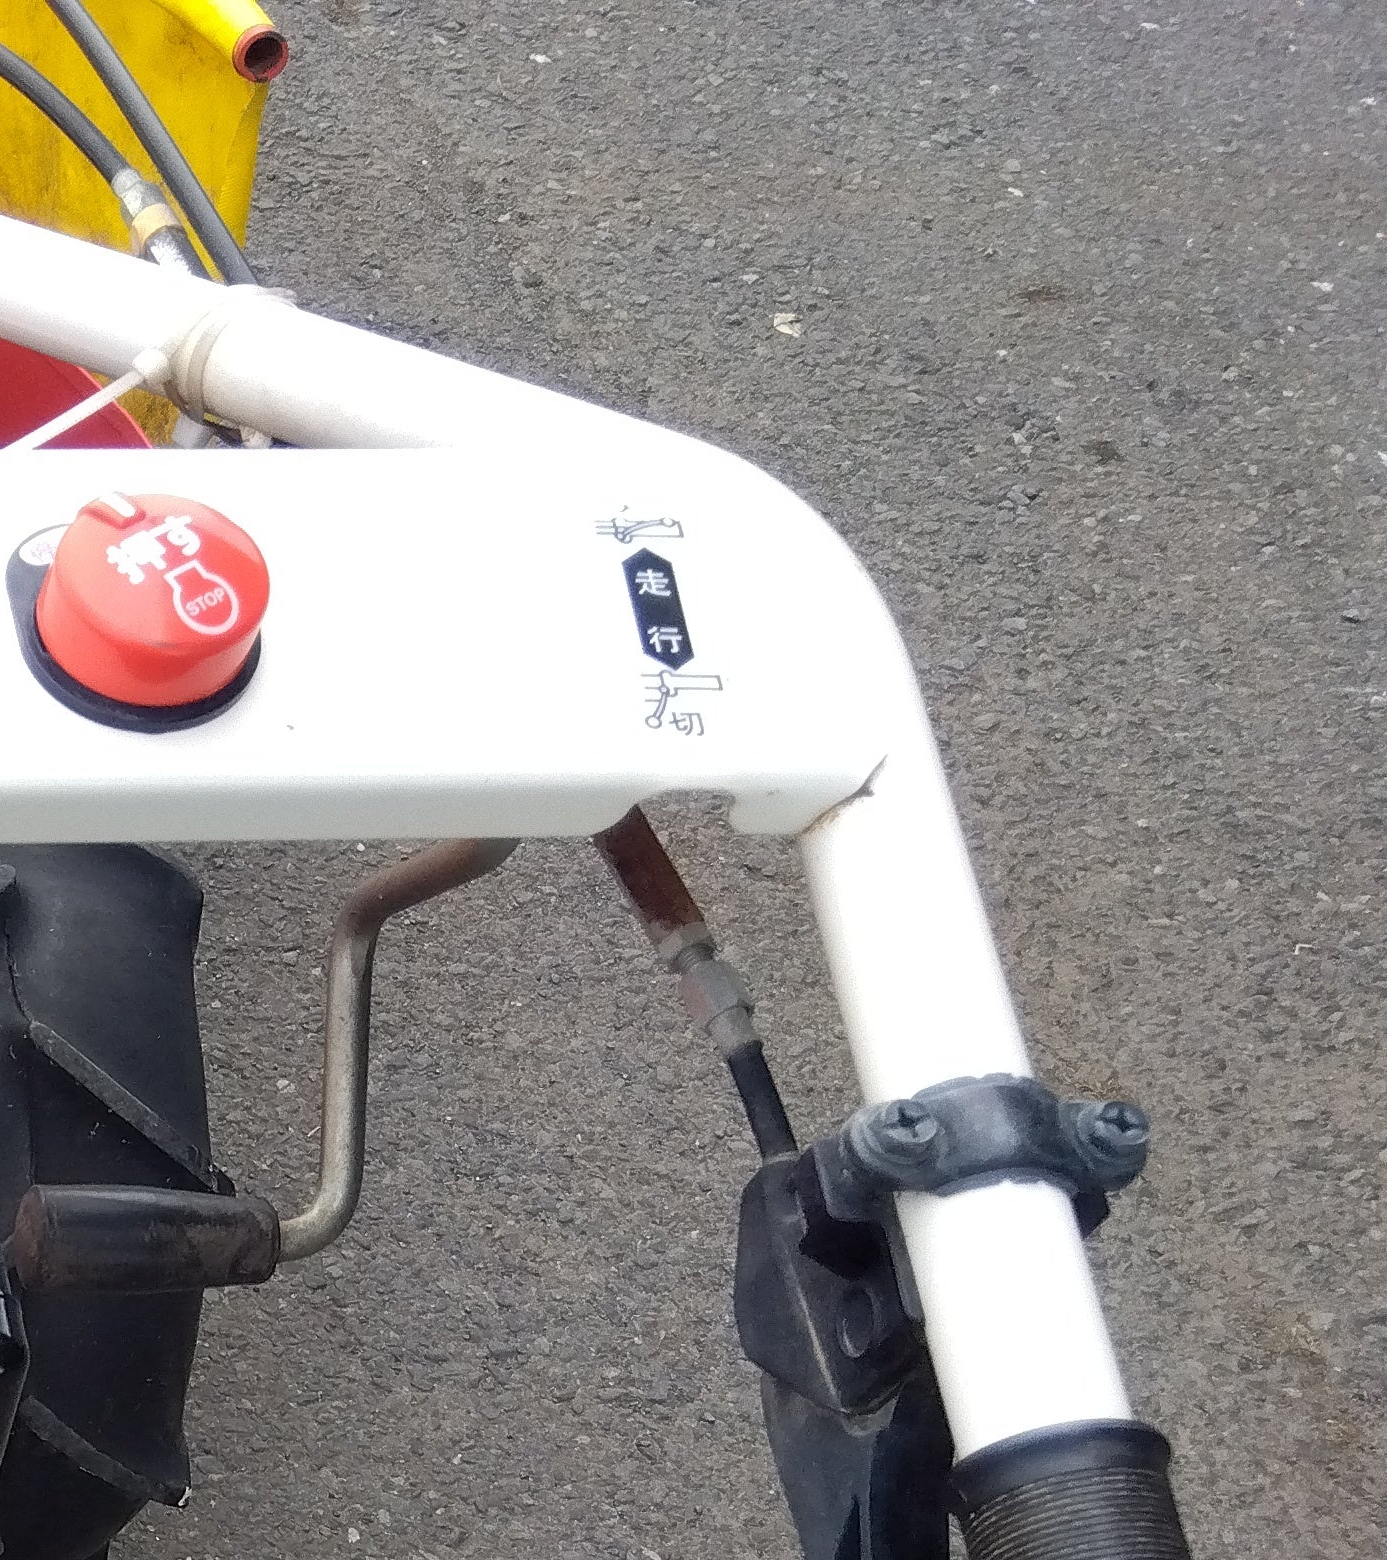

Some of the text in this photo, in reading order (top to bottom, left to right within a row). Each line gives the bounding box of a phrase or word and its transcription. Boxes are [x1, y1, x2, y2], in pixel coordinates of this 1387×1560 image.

[185, 587, 226, 618] STOP
[635, 568, 683, 653] 走行
[669, 712, 704, 736] 切
